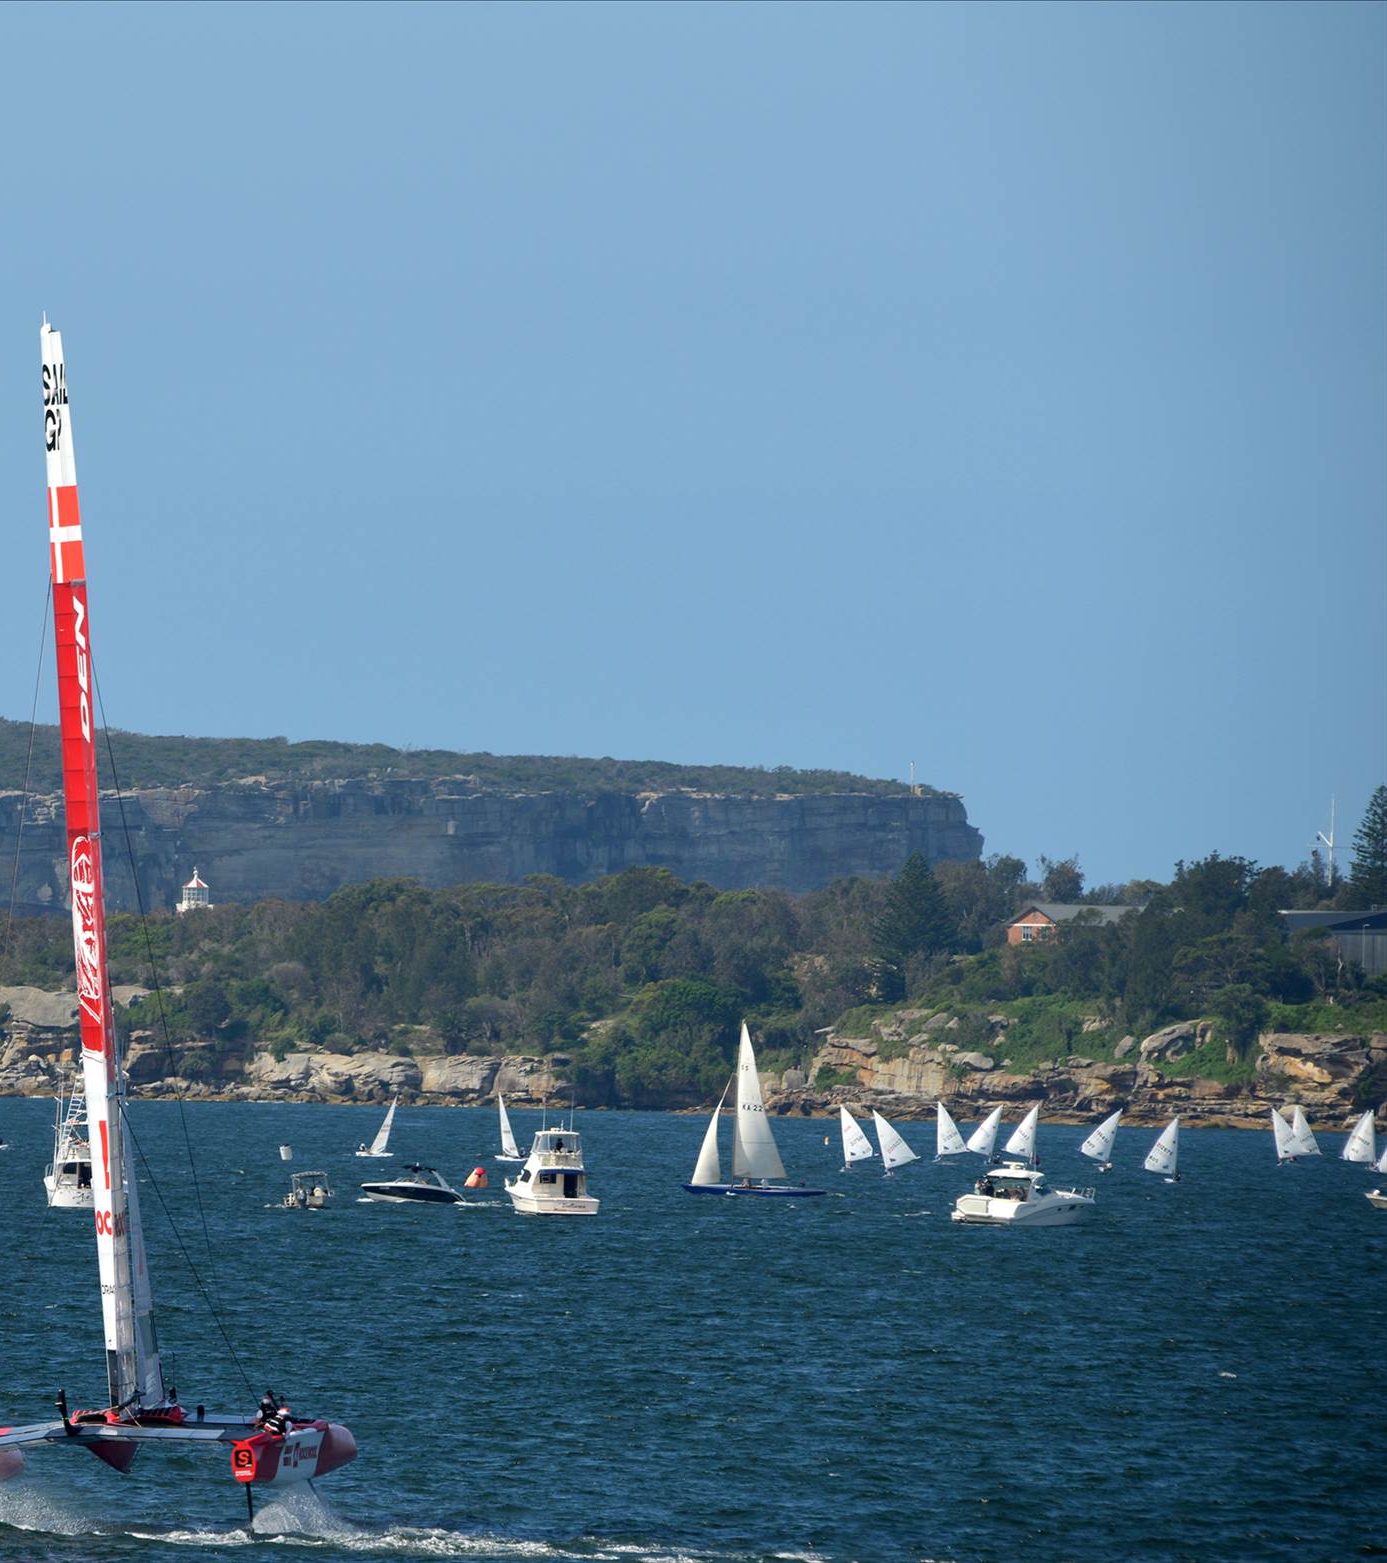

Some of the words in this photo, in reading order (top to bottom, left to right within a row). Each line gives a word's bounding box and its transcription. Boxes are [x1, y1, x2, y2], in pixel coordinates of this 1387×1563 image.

[42, 363, 69, 406] SAIL
[72, 596, 91, 744] DEN
[238, 1451, 250, 1466] S
